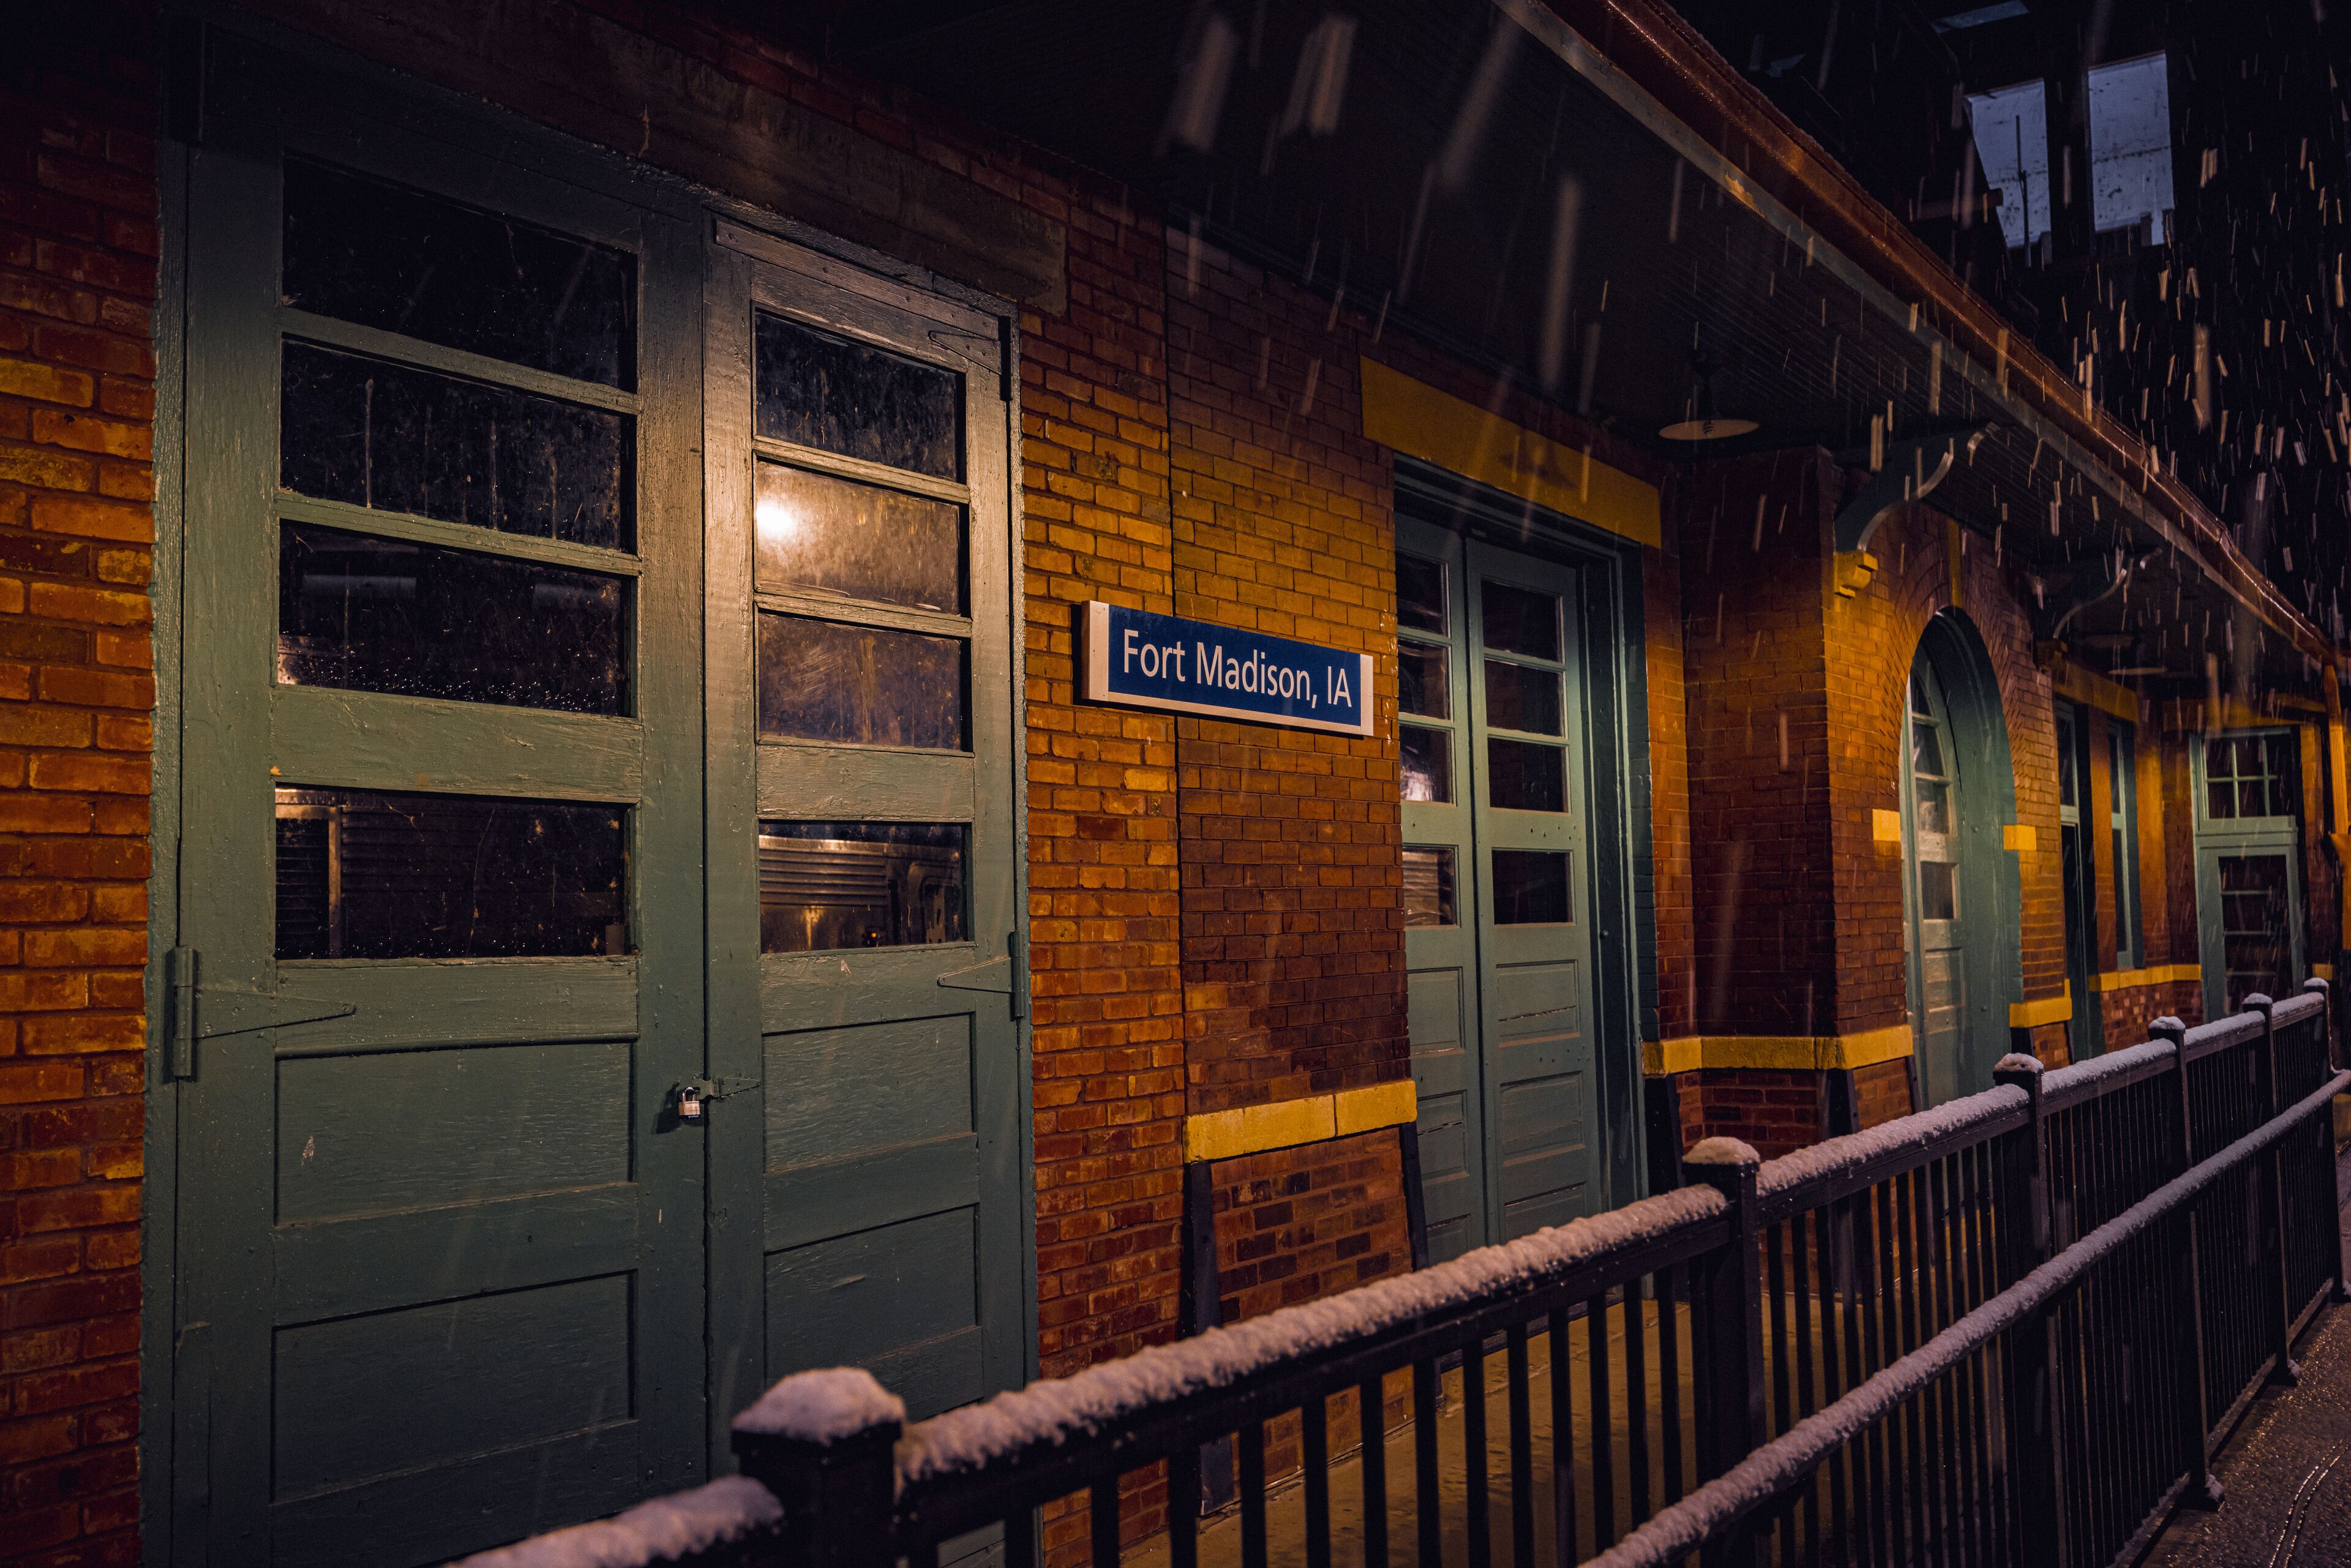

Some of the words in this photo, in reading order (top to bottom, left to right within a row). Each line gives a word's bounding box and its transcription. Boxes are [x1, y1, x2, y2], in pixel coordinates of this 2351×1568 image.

[1124, 629, 1185, 682] Fort
[1197, 642, 1318, 709] Madison,
[1327, 666, 1352, 708] IA
